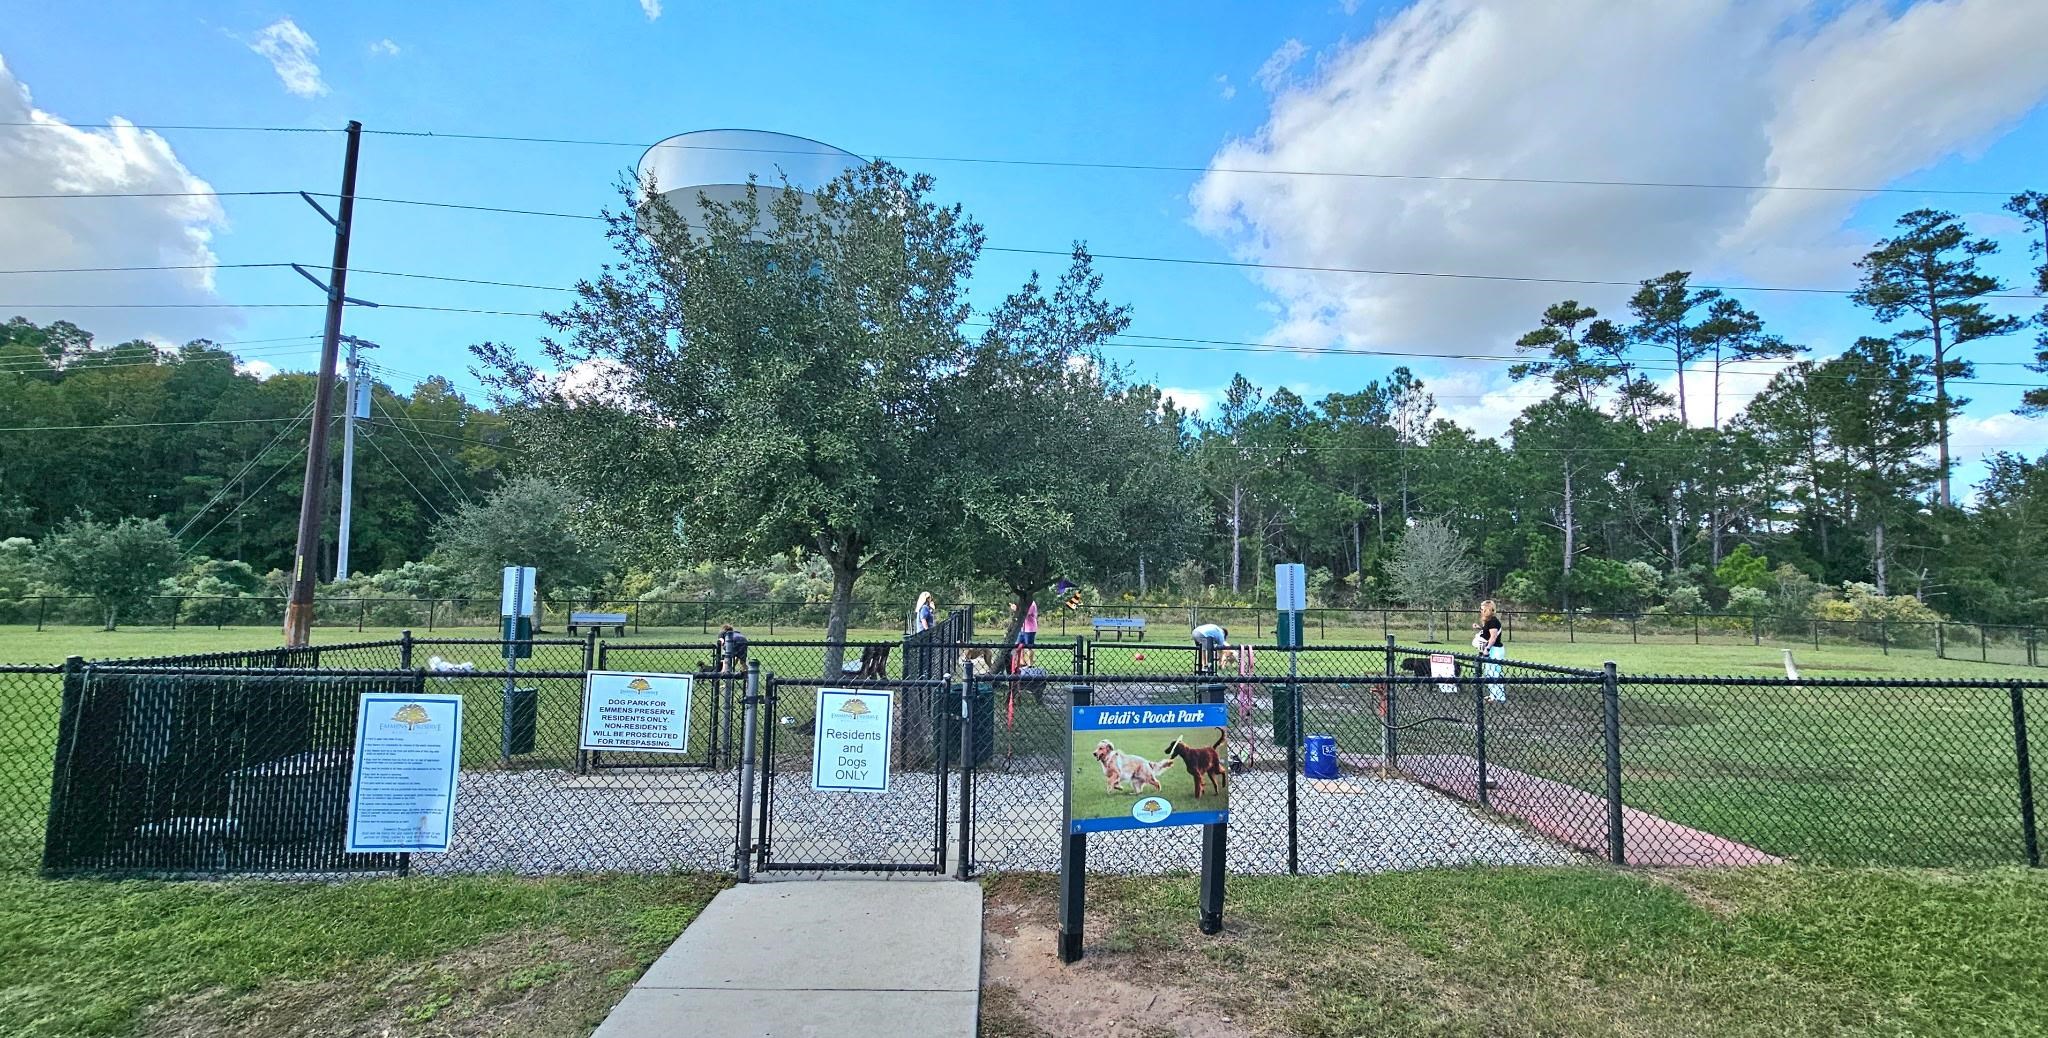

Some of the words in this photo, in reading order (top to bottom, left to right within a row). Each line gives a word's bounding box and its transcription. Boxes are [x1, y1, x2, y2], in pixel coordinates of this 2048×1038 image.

[1098, 711, 1140, 725] Heidi's
[1142, 709, 1175, 724] Pooch
[1177, 709, 1205, 723] Park
[604, 723, 668, 731] NON-RESIDENTS
[625, 731, 679, 739] PROSECUTED
[826, 728, 881, 741] Residents
[615, 739, 672, 747] TRESPASSING.
[842, 743, 864, 754] and
[838, 756, 867, 769] Dogs
[835, 769, 869, 781] ONLY
